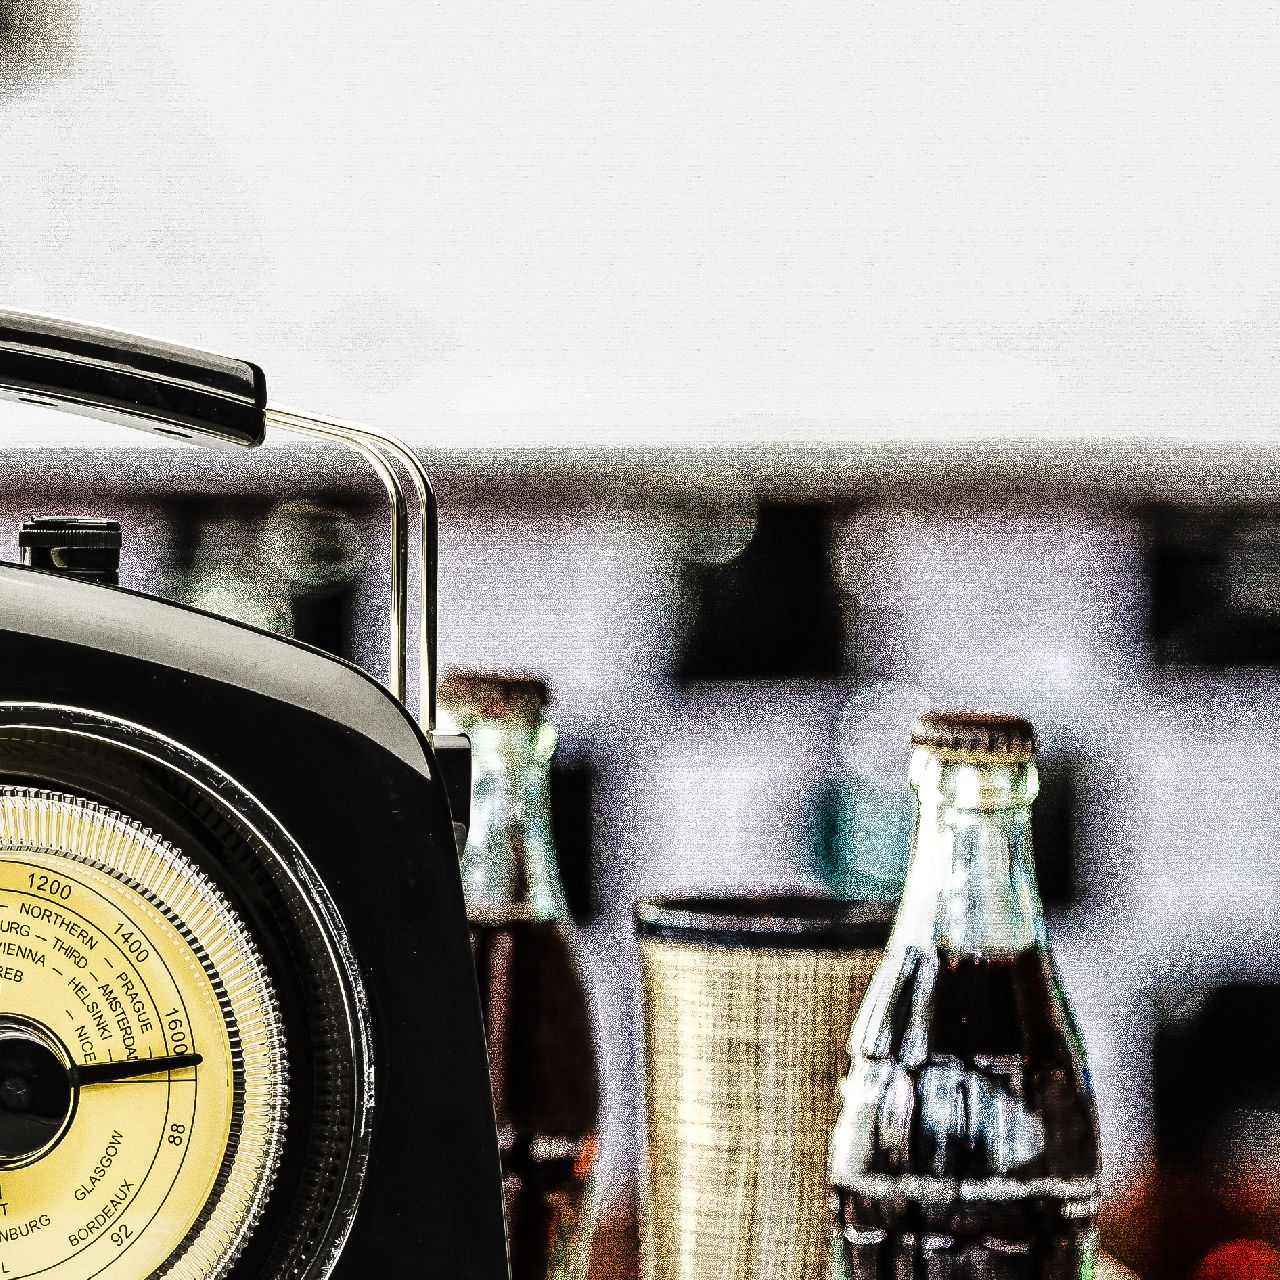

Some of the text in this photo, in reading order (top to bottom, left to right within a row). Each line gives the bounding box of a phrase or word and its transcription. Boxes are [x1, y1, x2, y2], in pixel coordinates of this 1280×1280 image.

[20, 903, 98, 950] NORTHERN
[116, 972, 153, 1034] PRAGUE
[28, 873, 72, 900] 1200
[114, 923, 149, 963] 1400
[165, 1008, 188, 1055] 1600
[53, 937, 87, 969] THIRD
[68, 977, 112, 1041] HELSINKI
[75, 1025, 96, 1064] NICE
[74, 1129, 123, 1201] GLASGOW
[110, 1224, 134, 1247] 92
[168, 1123, 186, 1146] 88
[68, 1178, 134, 1247] BORDEAUX
